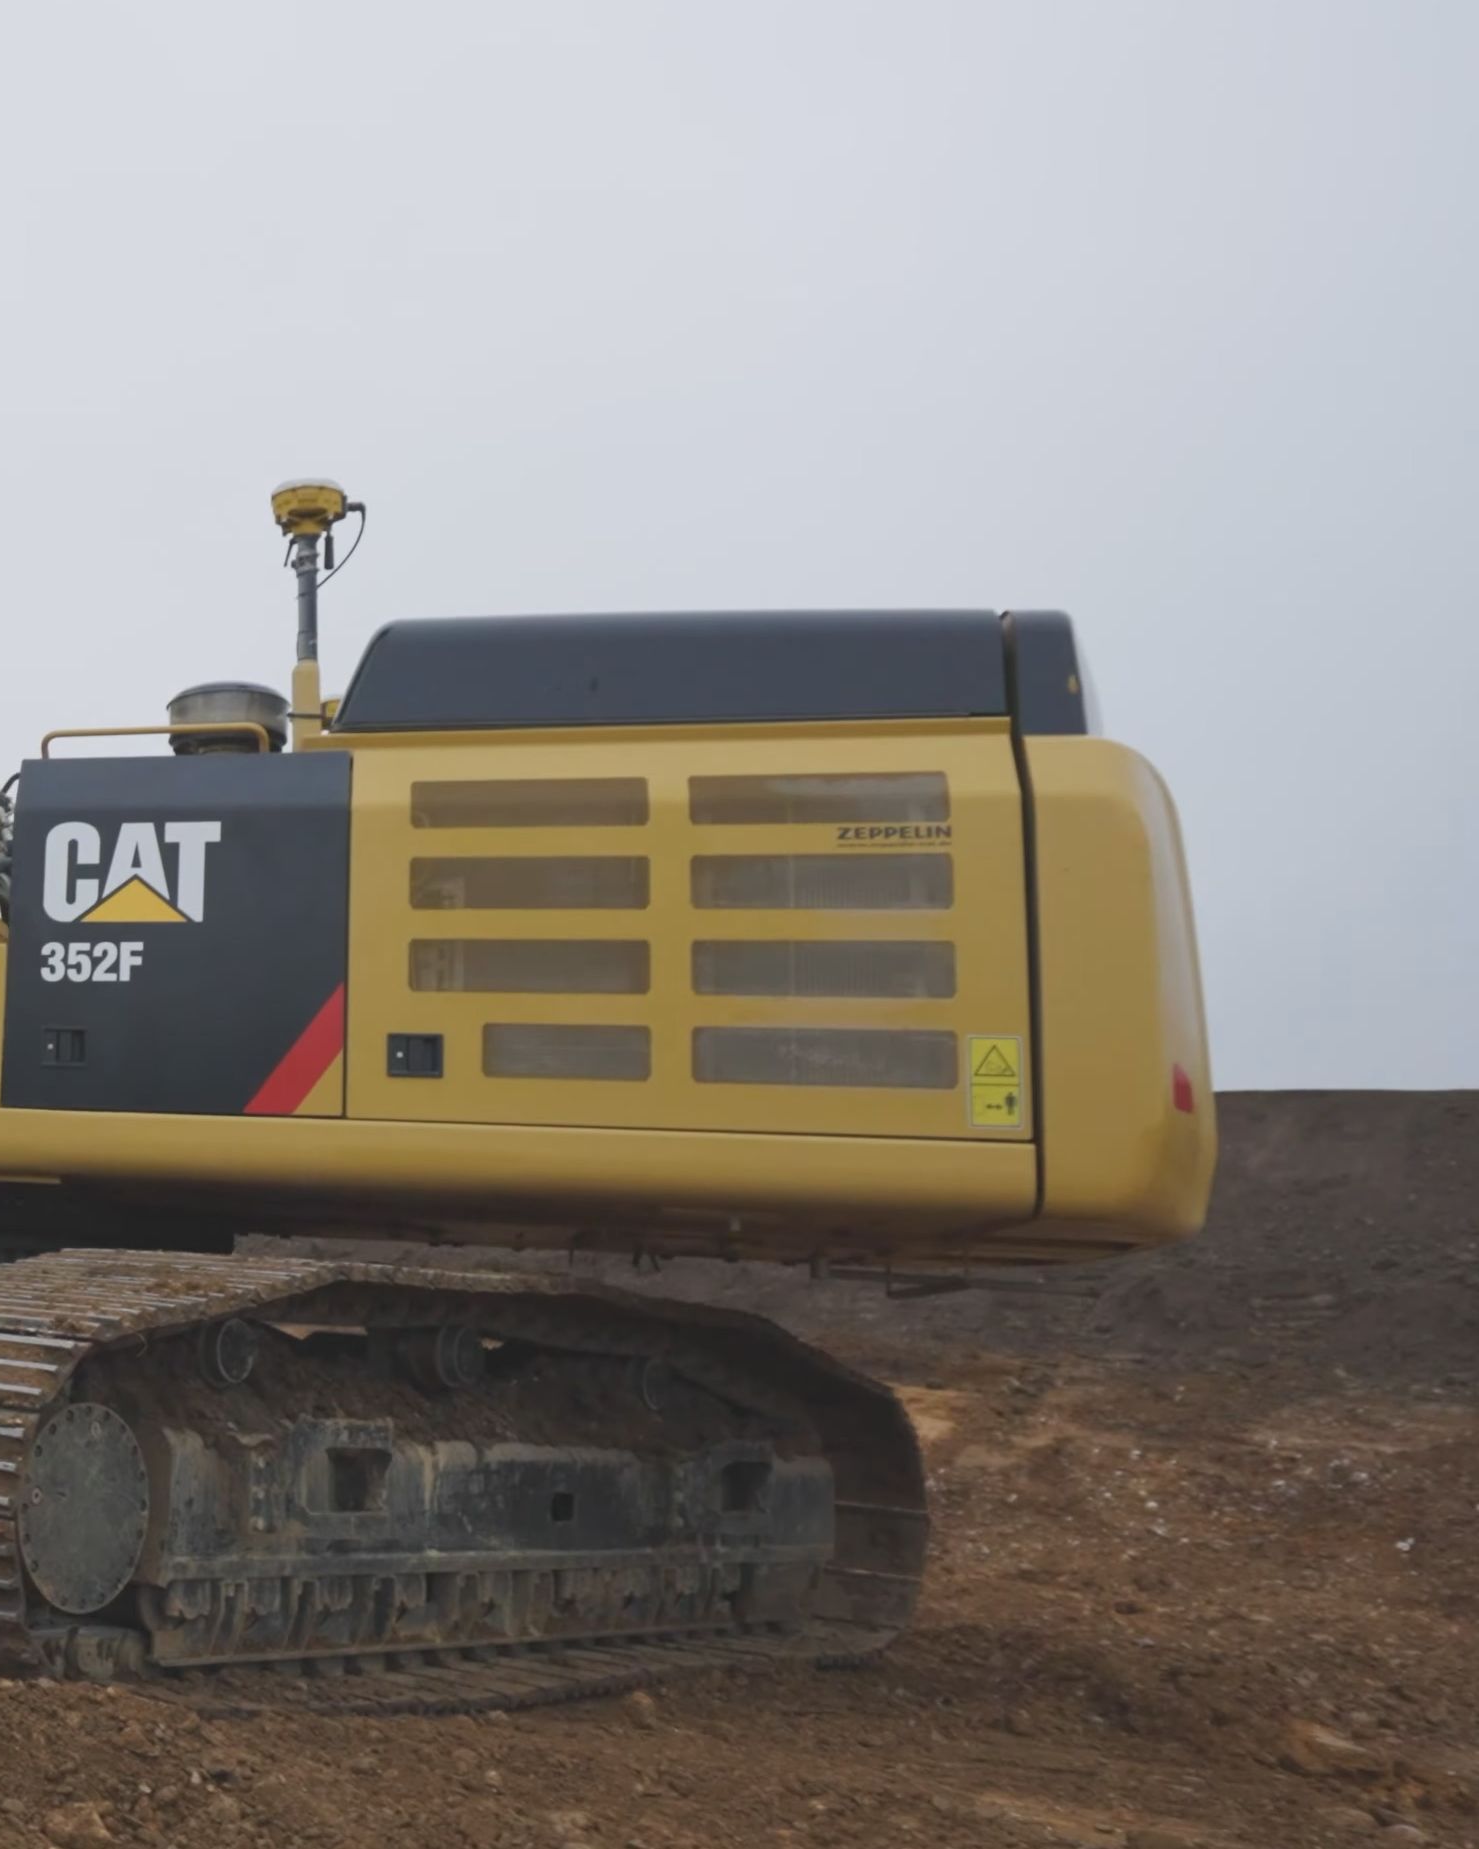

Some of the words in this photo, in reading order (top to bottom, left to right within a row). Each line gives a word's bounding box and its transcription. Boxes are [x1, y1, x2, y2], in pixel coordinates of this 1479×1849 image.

[836, 825, 953, 840] ZEPPELIN
[43, 821, 222, 923] CAT
[40, 941, 144, 982] 352F
